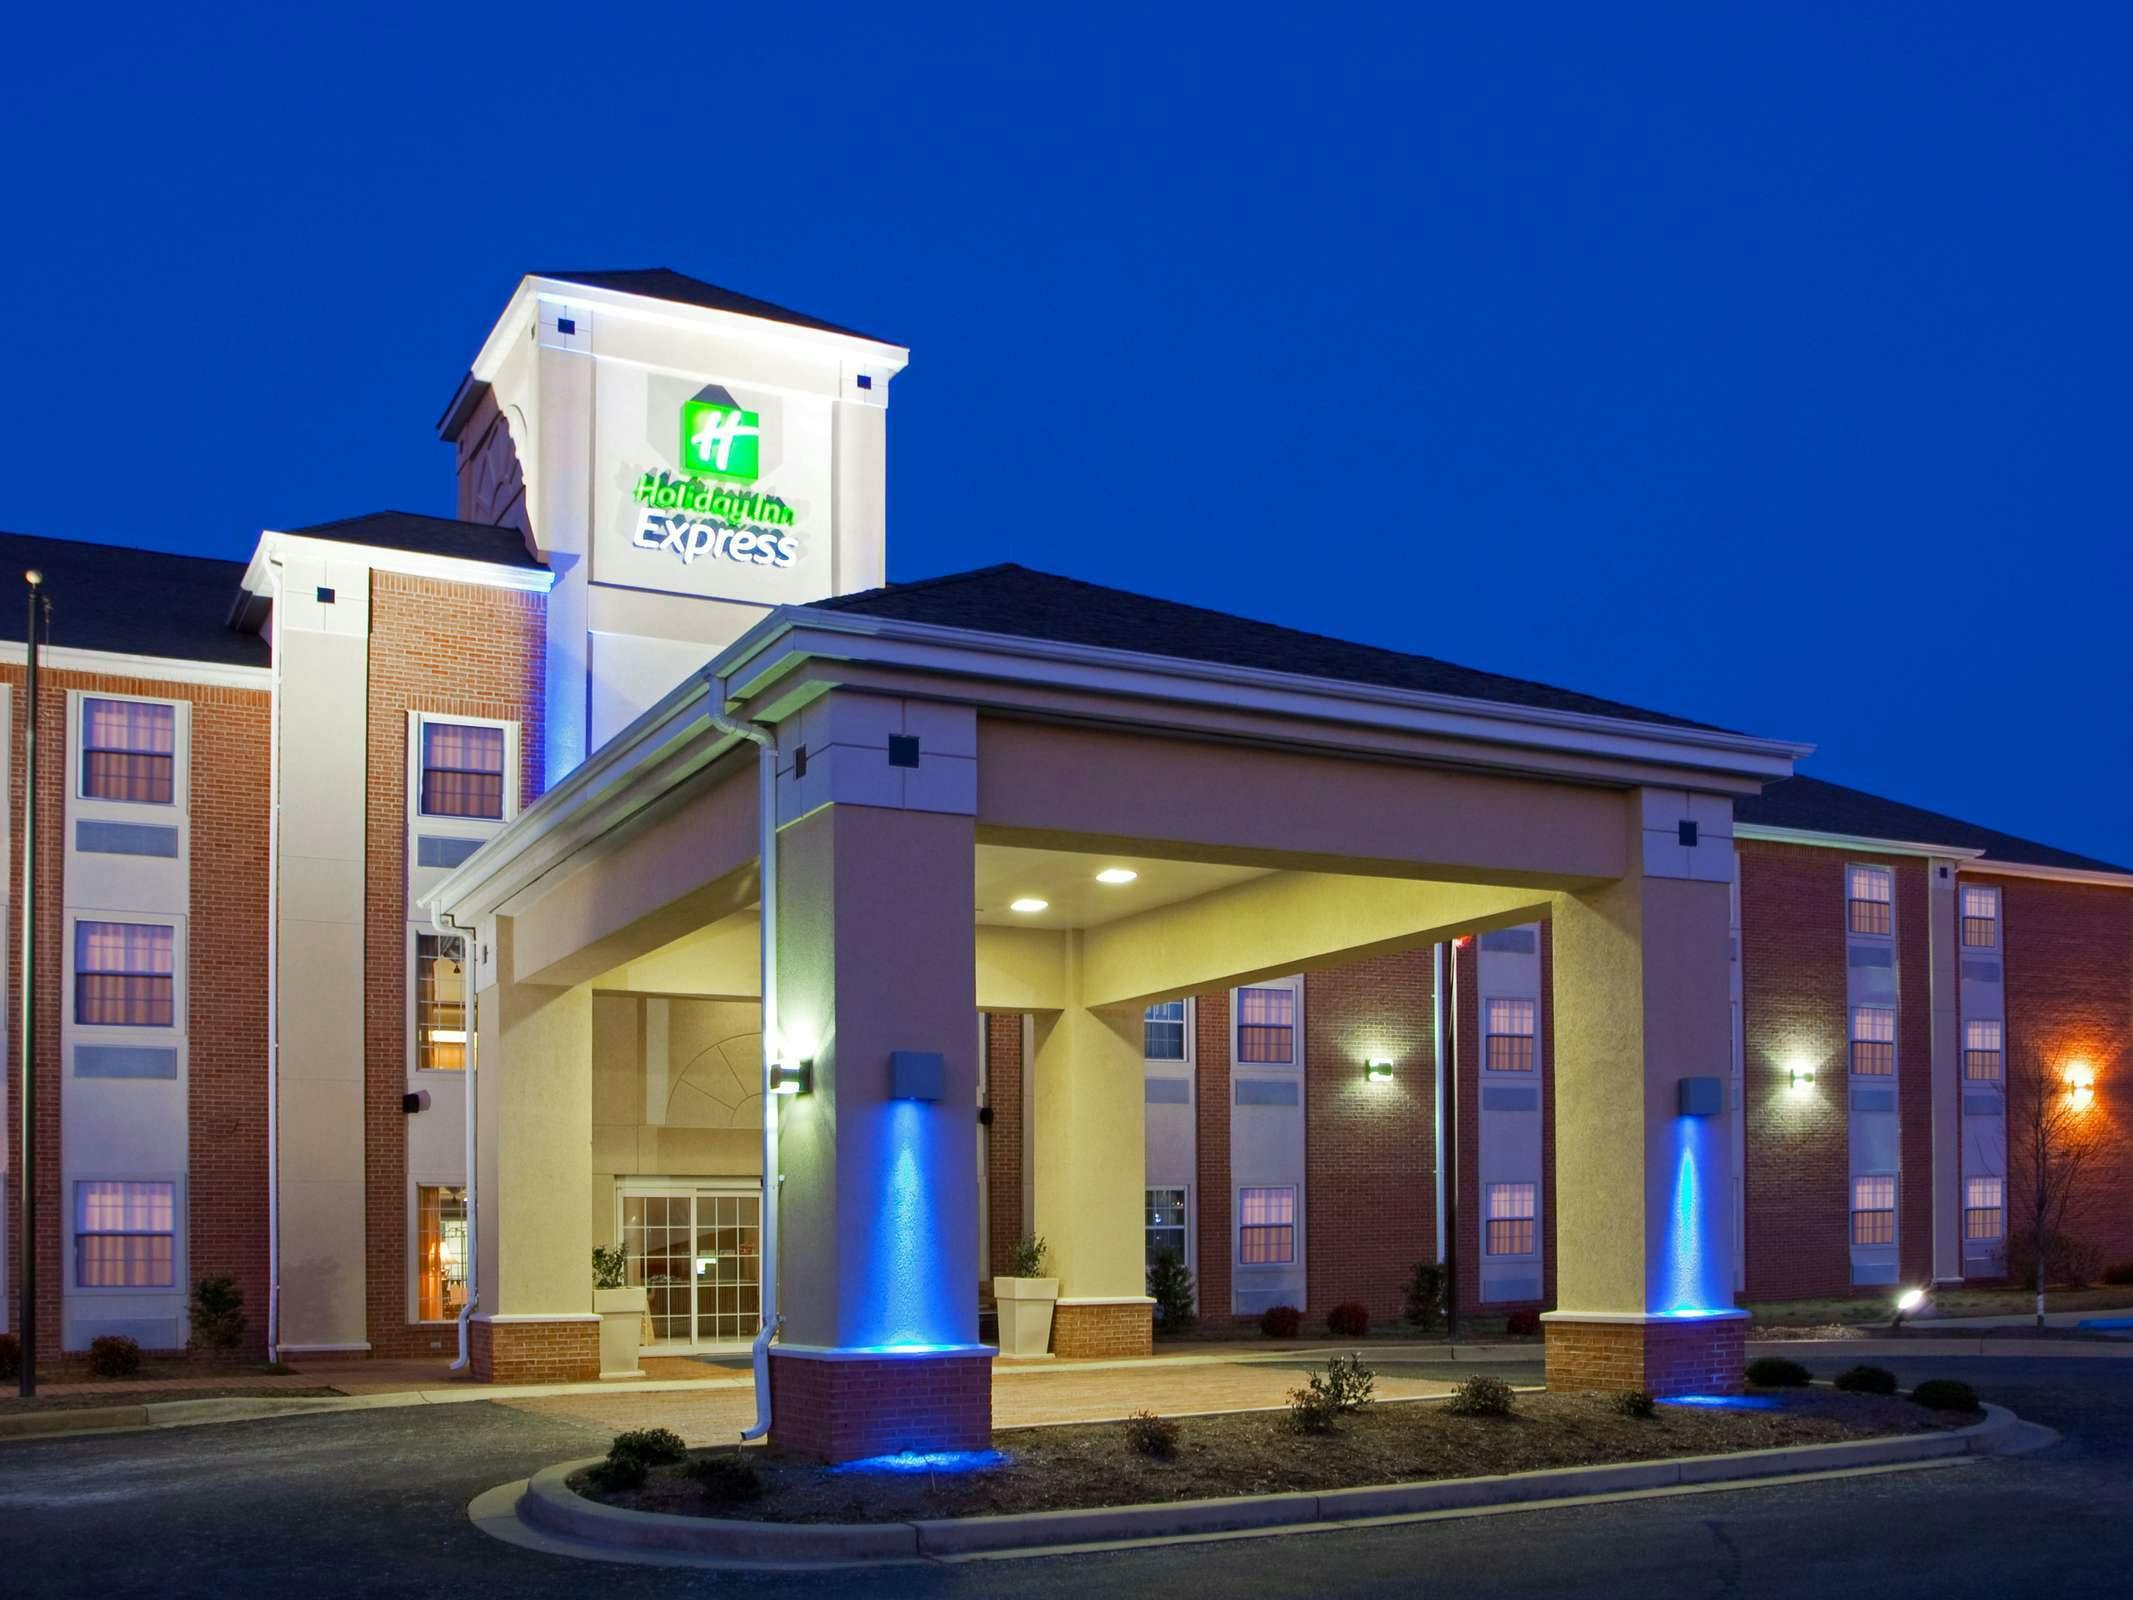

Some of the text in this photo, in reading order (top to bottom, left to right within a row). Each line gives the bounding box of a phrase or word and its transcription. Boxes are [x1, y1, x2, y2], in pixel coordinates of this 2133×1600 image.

[633, 472, 797, 527] Holiday Inn
[633, 507, 799, 567] Express
